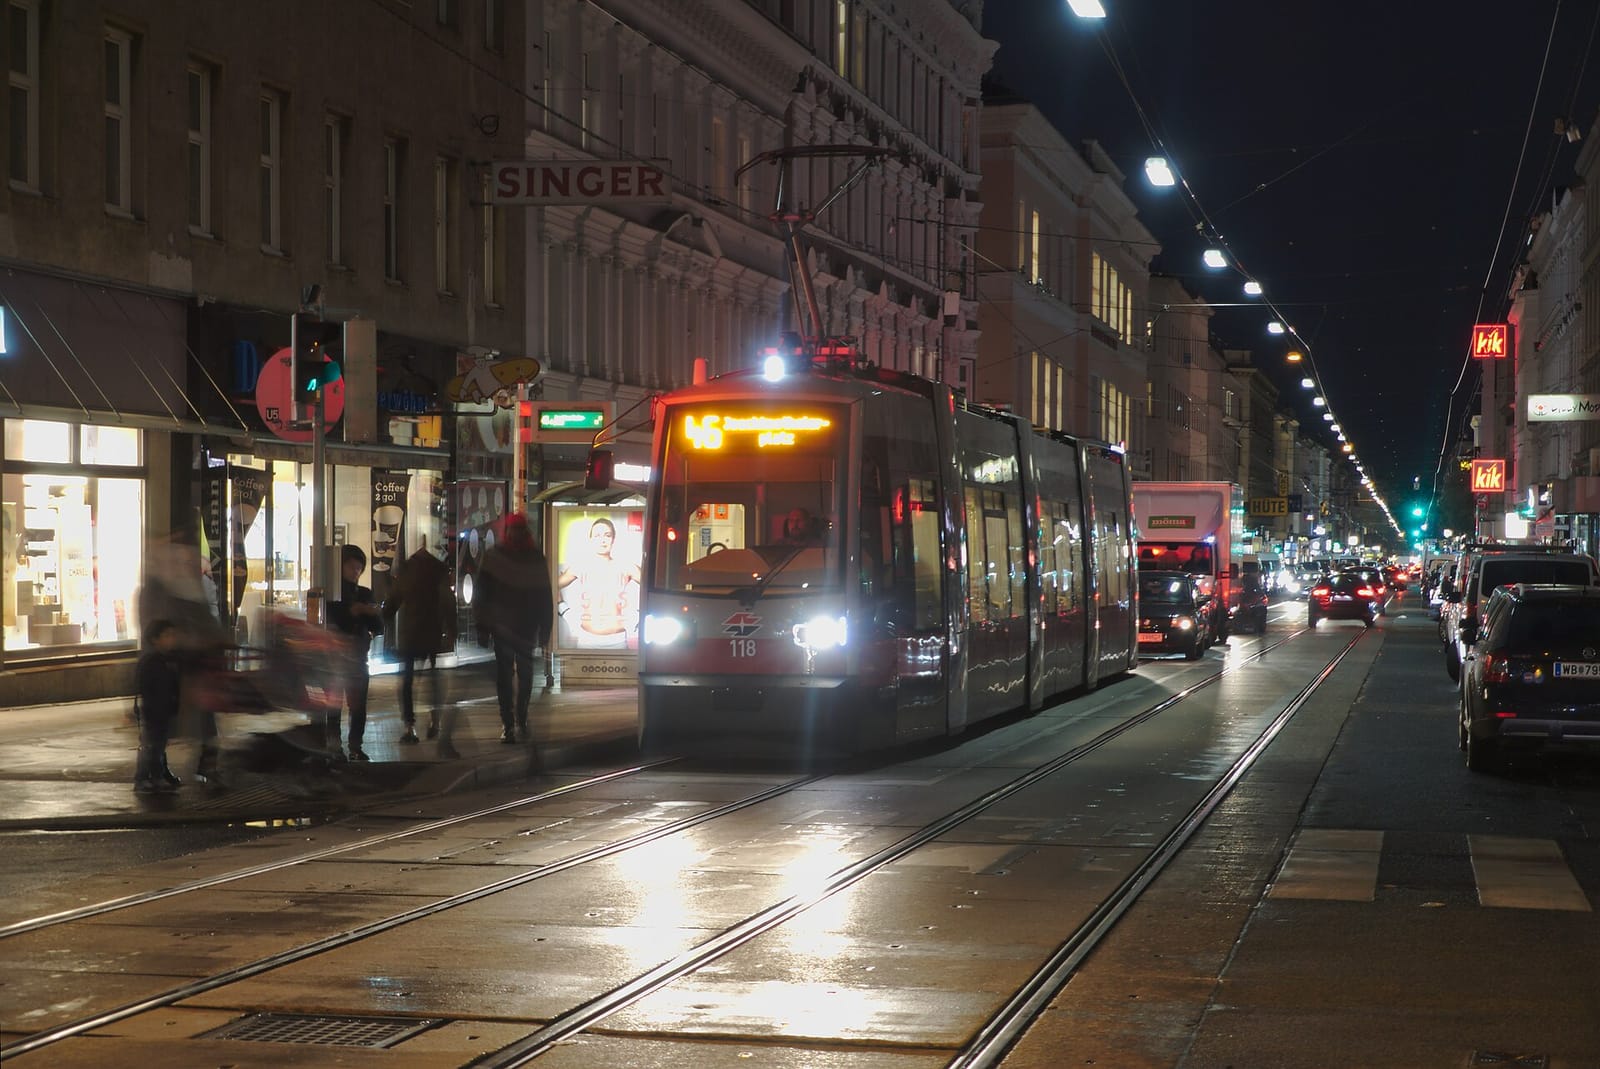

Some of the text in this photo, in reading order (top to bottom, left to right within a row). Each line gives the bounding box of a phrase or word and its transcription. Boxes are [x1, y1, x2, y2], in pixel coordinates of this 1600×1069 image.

[497, 166, 665, 198] SINGER
[1476, 328, 1503, 354] kik
[266, 409, 279, 420] U5
[685, 415, 723, 449] 46
[234, 477, 265, 490] Coffee
[1475, 463, 1502, 488] kik
[375, 482, 405, 492] Coffee
[1252, 498, 1285, 513] HÜTE
[729, 639, 757, 658] 118
[1563, 664, 1577, 675] WB
